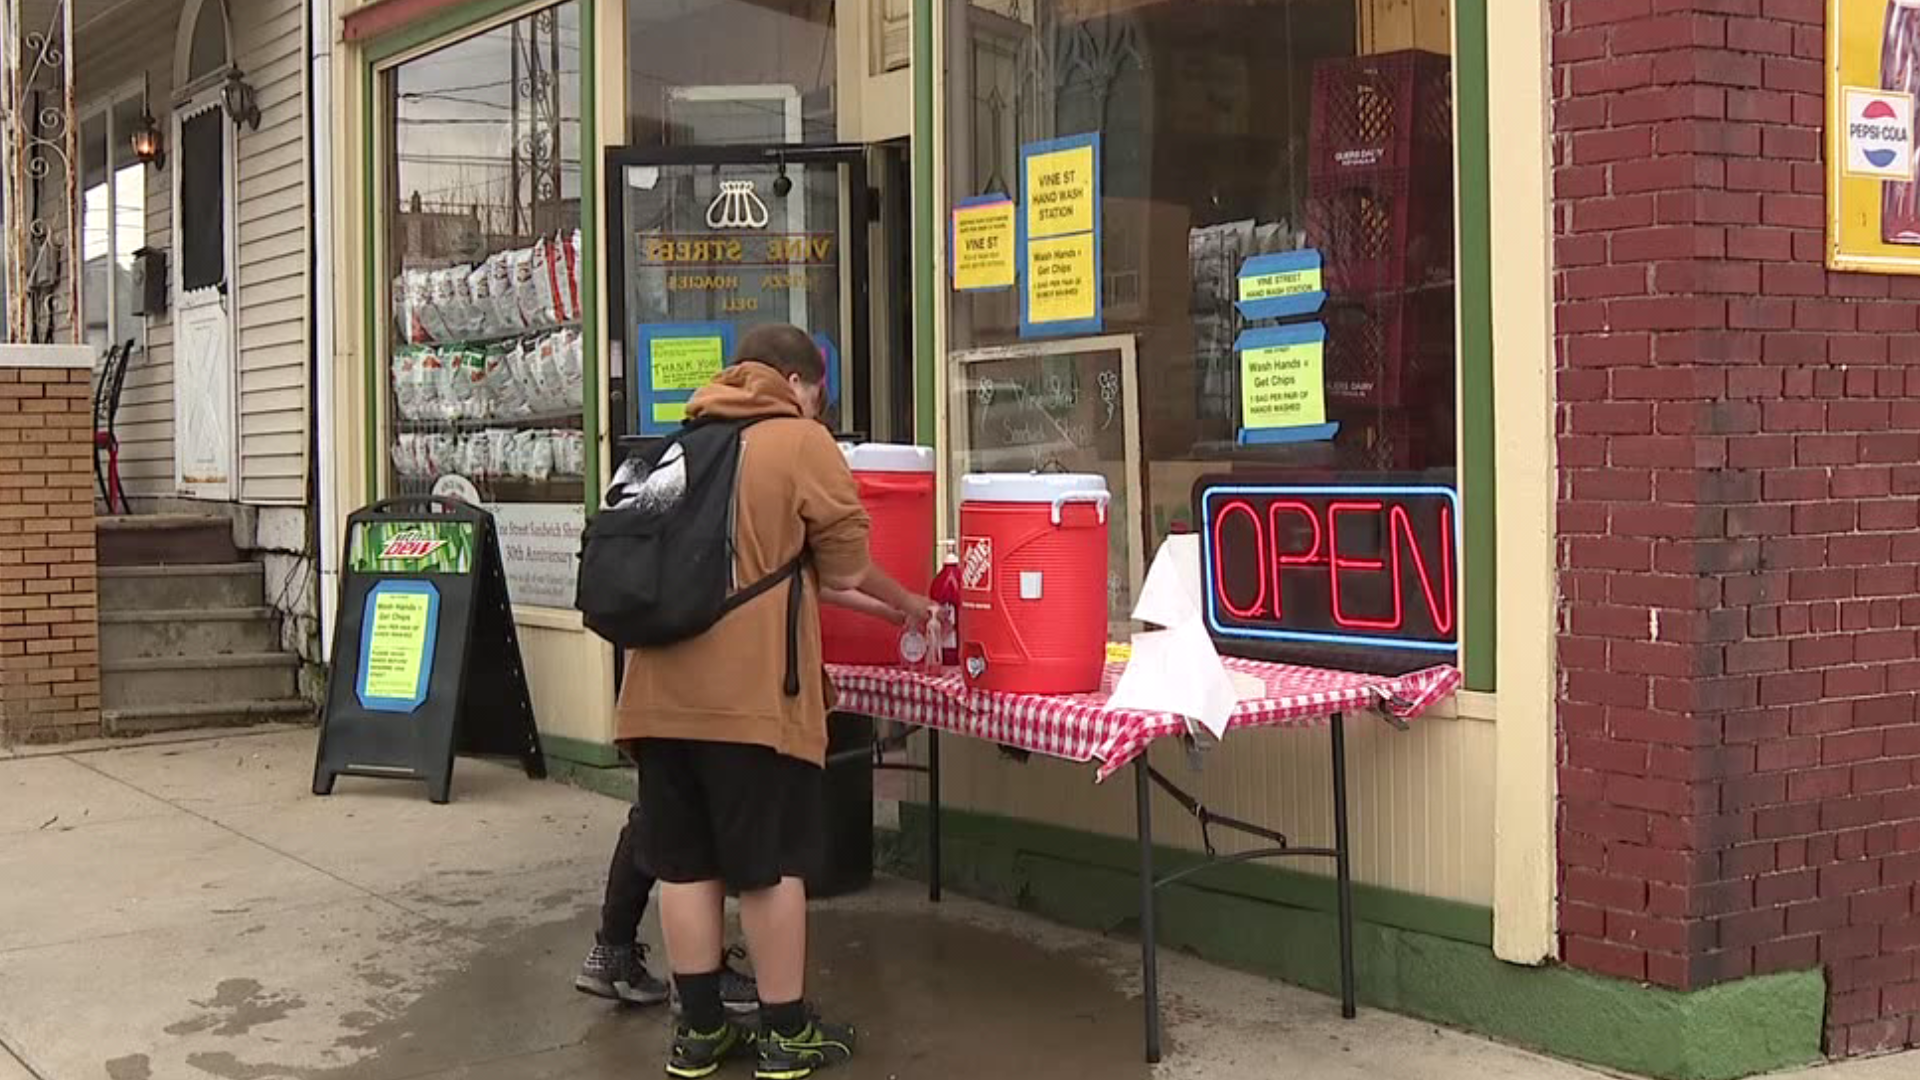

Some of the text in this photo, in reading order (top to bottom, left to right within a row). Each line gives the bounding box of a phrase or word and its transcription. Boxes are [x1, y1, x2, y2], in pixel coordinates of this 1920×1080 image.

[1038, 170, 1076, 187] VINE ST
[1032, 187, 1084, 205] HAND WASH
[1039, 205, 1074, 221] STATION
[965, 236, 998, 251] VINE ST
[1248, 360, 1272, 373] Wash
[1274, 358, 1301, 371] Hands
[1254, 374, 1296, 388] Get Chips
[1214, 500, 1452, 634] OPEN
